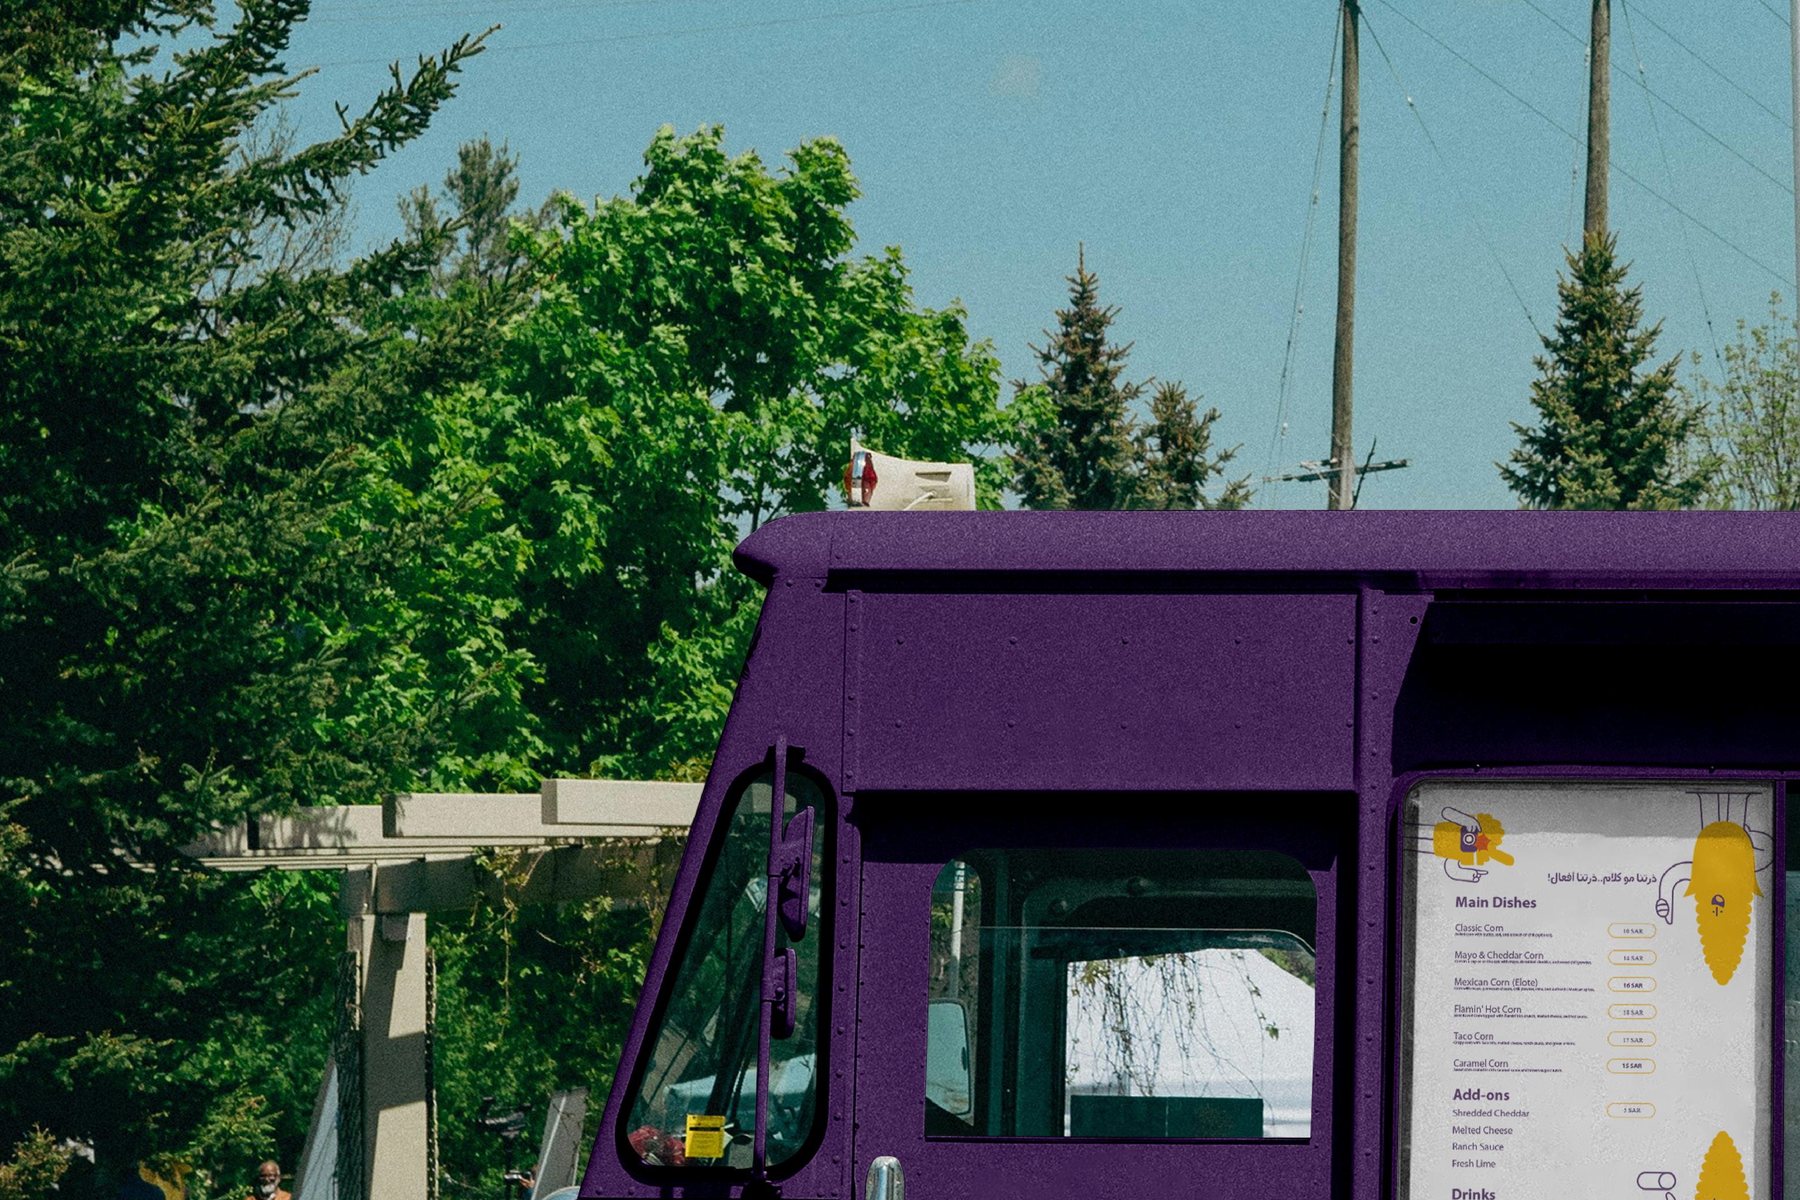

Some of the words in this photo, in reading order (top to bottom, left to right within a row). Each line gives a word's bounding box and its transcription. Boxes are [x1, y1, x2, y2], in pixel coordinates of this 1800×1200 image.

[1624, 877, 1635, 885] مو
[1455, 896, 1489, 909] Main
[1492, 896, 1537, 909] Dishes
[1455, 923, 1482, 932] Classic
[1484, 923, 1504, 932] Corn
[1454, 951, 1478, 961] Mayo
[1479, 951, 1486, 960] &
[1487, 951, 1522, 960] Cheddar
[1524, 951, 1544, 960] Corn
[1454, 978, 1488, 987] Mexican
[1490, 978, 1510, 987] Corn
[1512, 978, 1538, 987] (Elote)
[1454, 1005, 1484, 1014] Flamin'
[1485, 1005, 1500, 1014] Hot
[1502, 1005, 1522, 1014] Corn
[1454, 1032, 1473, 1041] Taco
[1474, 1032, 1494, 1041] Corn
[1453, 1059, 1487, 1068] Caramel
[1489, 1059, 1509, 1068] Corn
[1453, 1088, 1510, 1101] Add-ons
[1452, 1109, 1492, 1117] Shredded
[1494, 1109, 1530, 1117] Cheddar
[1452, 1126, 1481, 1135] Melted
[1483, 1126, 1513, 1135] Cheese
[1452, 1142, 1478, 1151] Ranch
[1480, 1143, 1504, 1151] Sauce
[1452, 1159, 1474, 1168] Fresh
[1476, 1159, 1496, 1168] Lime
[1452, 1188, 1496, 1200] Drinks
